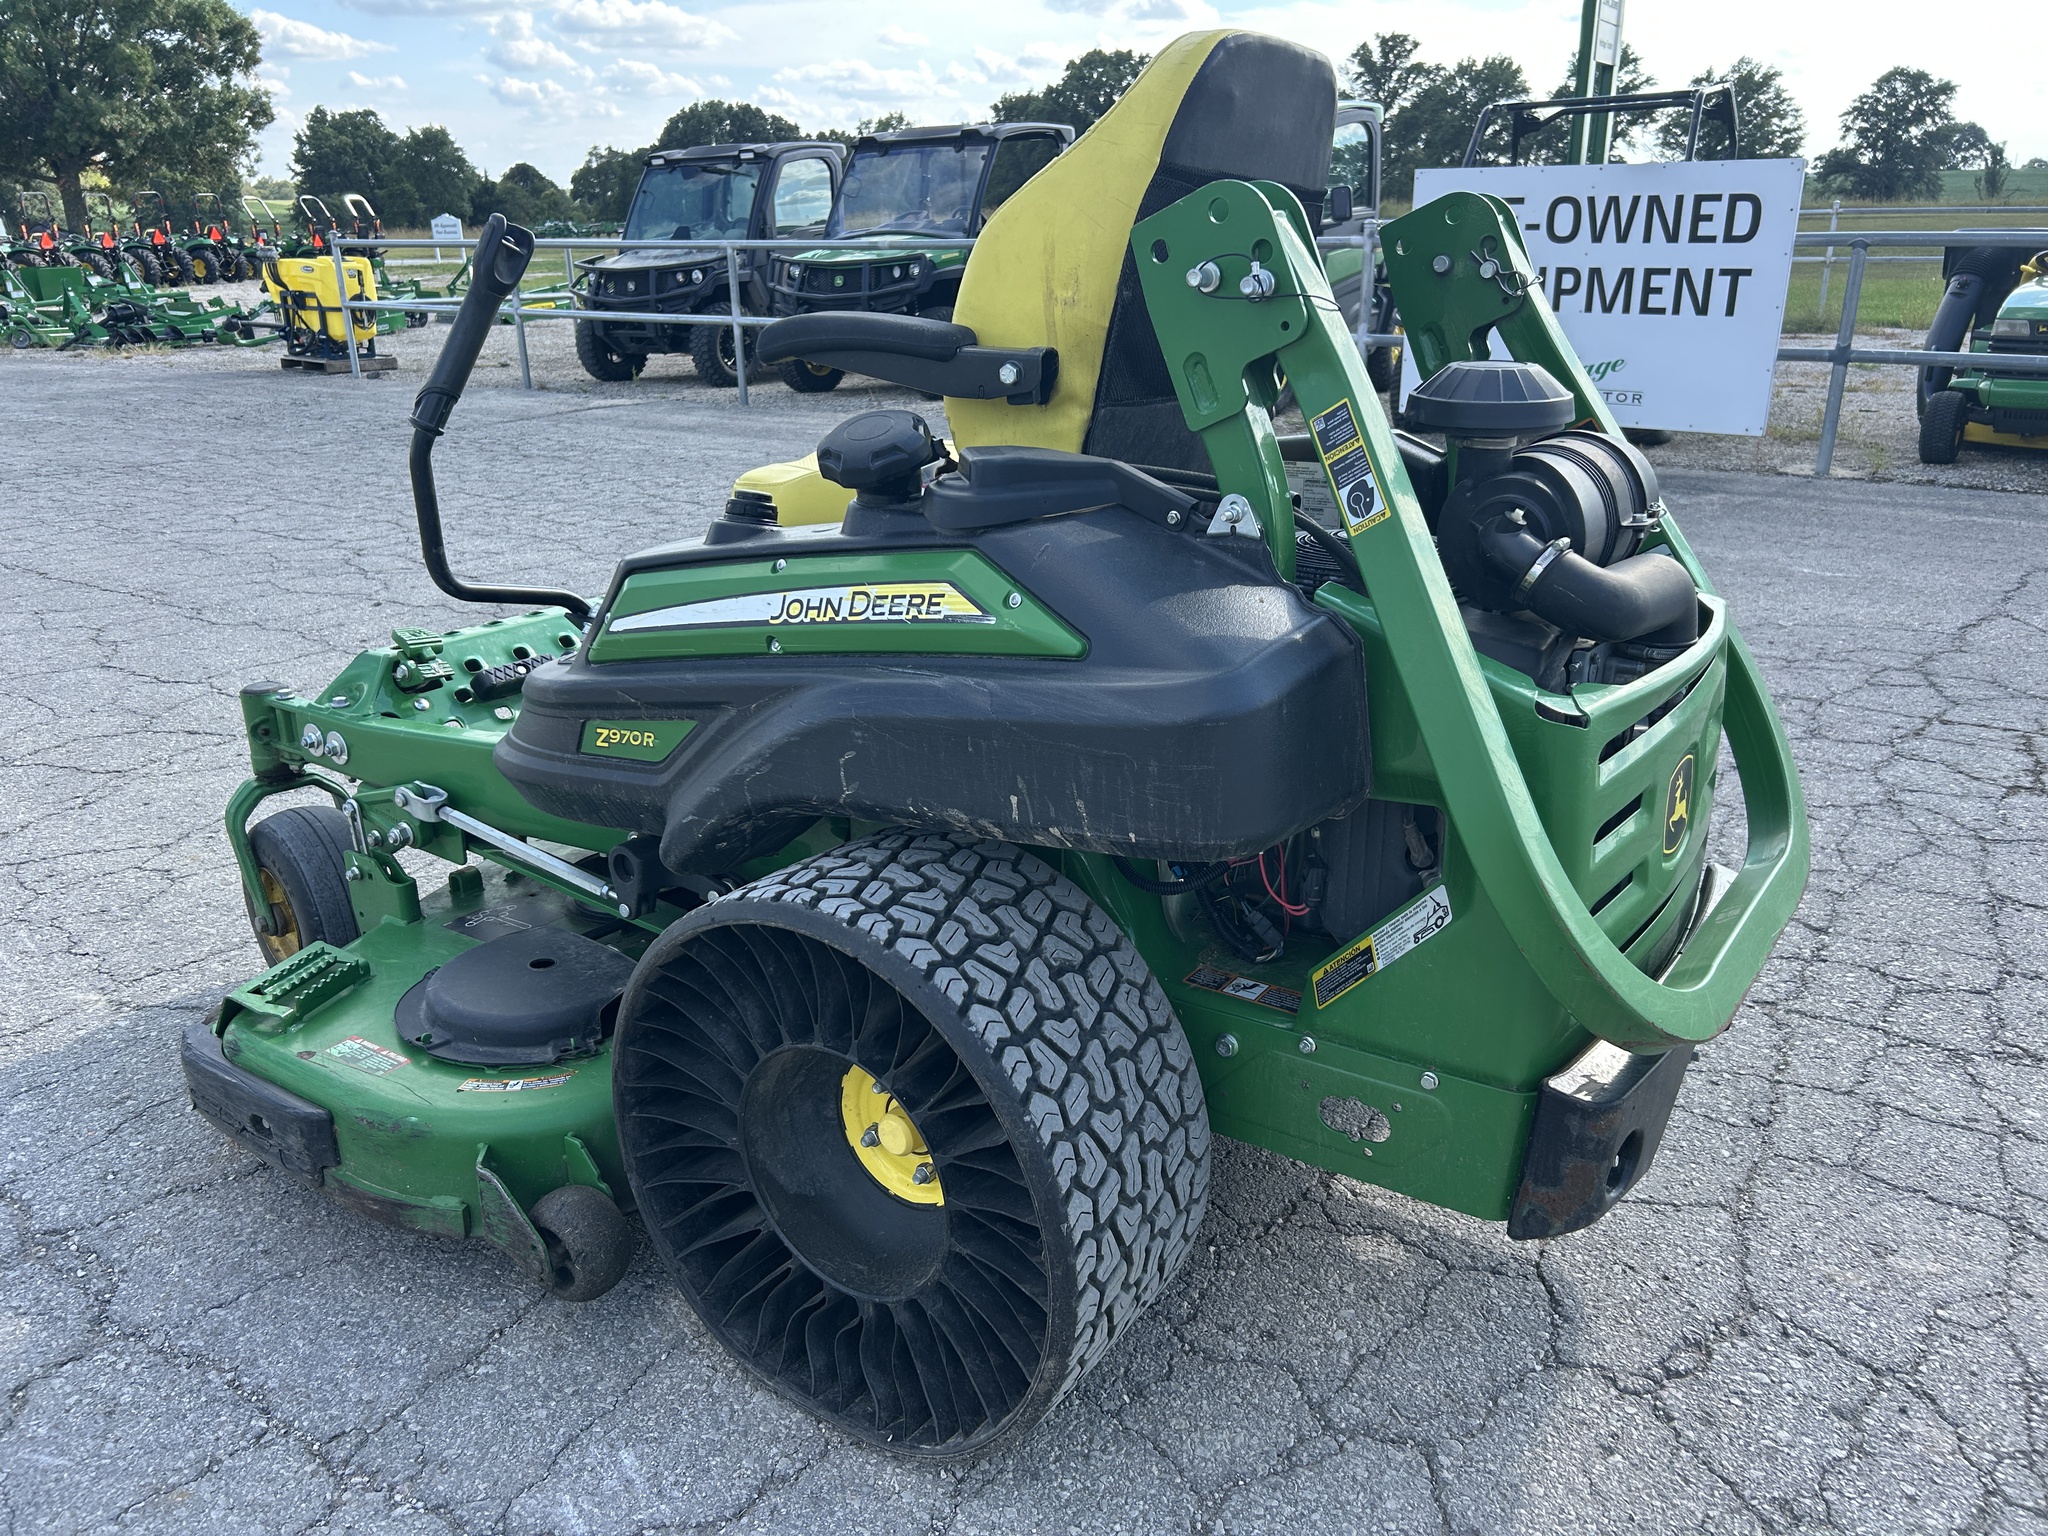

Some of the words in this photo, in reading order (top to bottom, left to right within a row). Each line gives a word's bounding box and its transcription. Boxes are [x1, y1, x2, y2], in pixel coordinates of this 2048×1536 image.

[1502, 193, 1762, 244] -OWNED
[769, 594, 843, 622] JOHN
[848, 590, 946, 619] DEERE
[595, 727, 656, 748] Z970R
